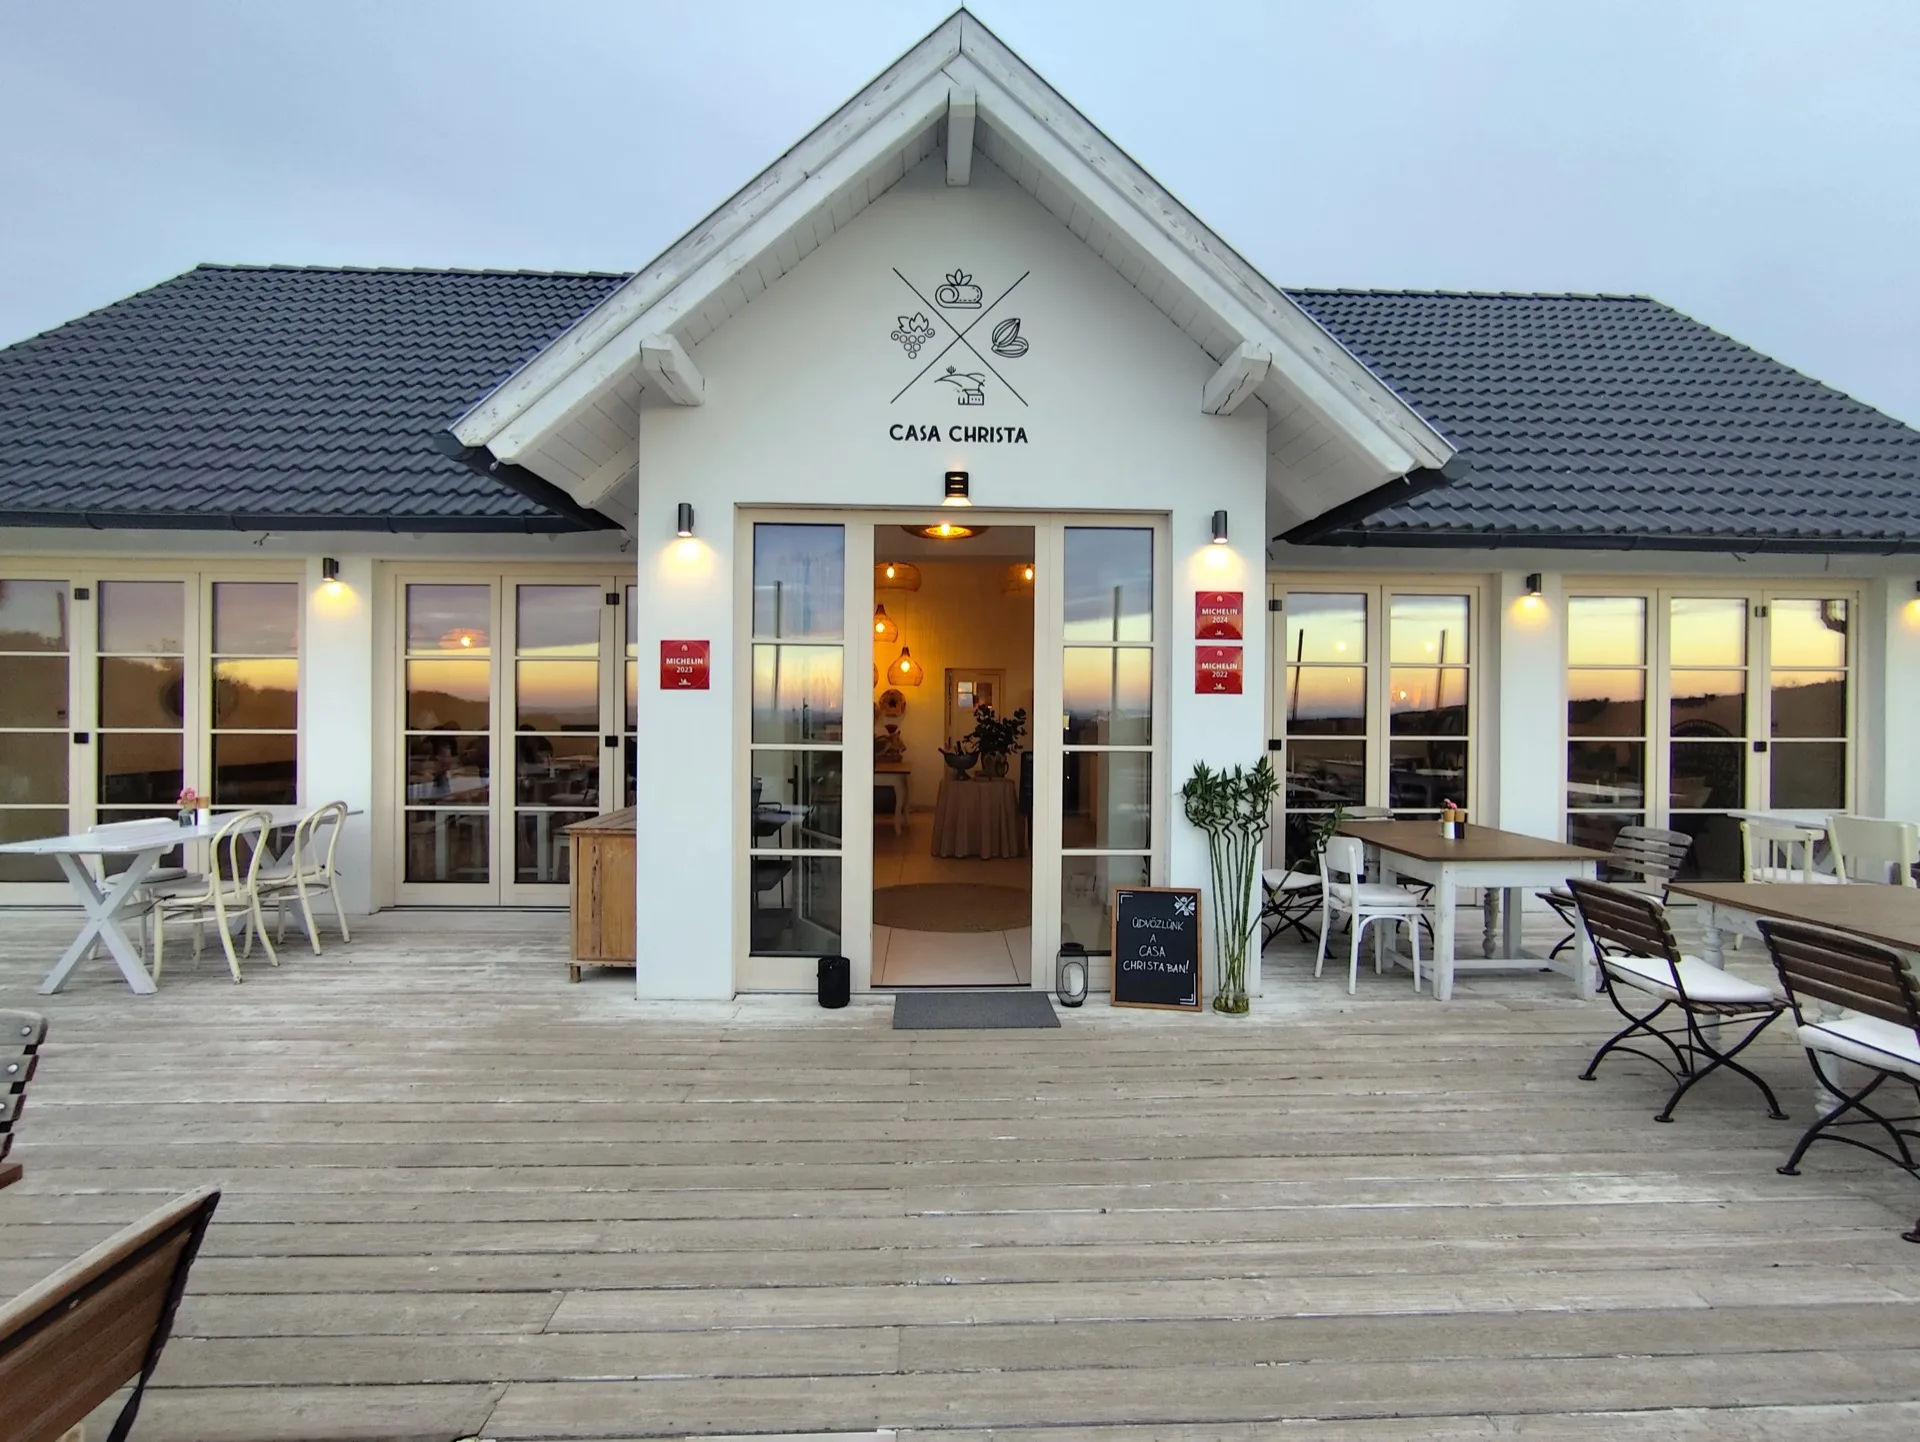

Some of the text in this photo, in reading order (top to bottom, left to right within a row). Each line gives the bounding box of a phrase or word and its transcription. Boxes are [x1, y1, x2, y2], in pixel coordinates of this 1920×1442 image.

[889, 424, 1028, 443] CASA CHRISTA
[1212, 616, 1228, 624] 2024
[666, 657, 704, 665] MICHELIN
[1201, 662, 1238, 670] MICHELIN
[1149, 933, 1157, 943] A
[1139, 945, 1166, 958] CASA
